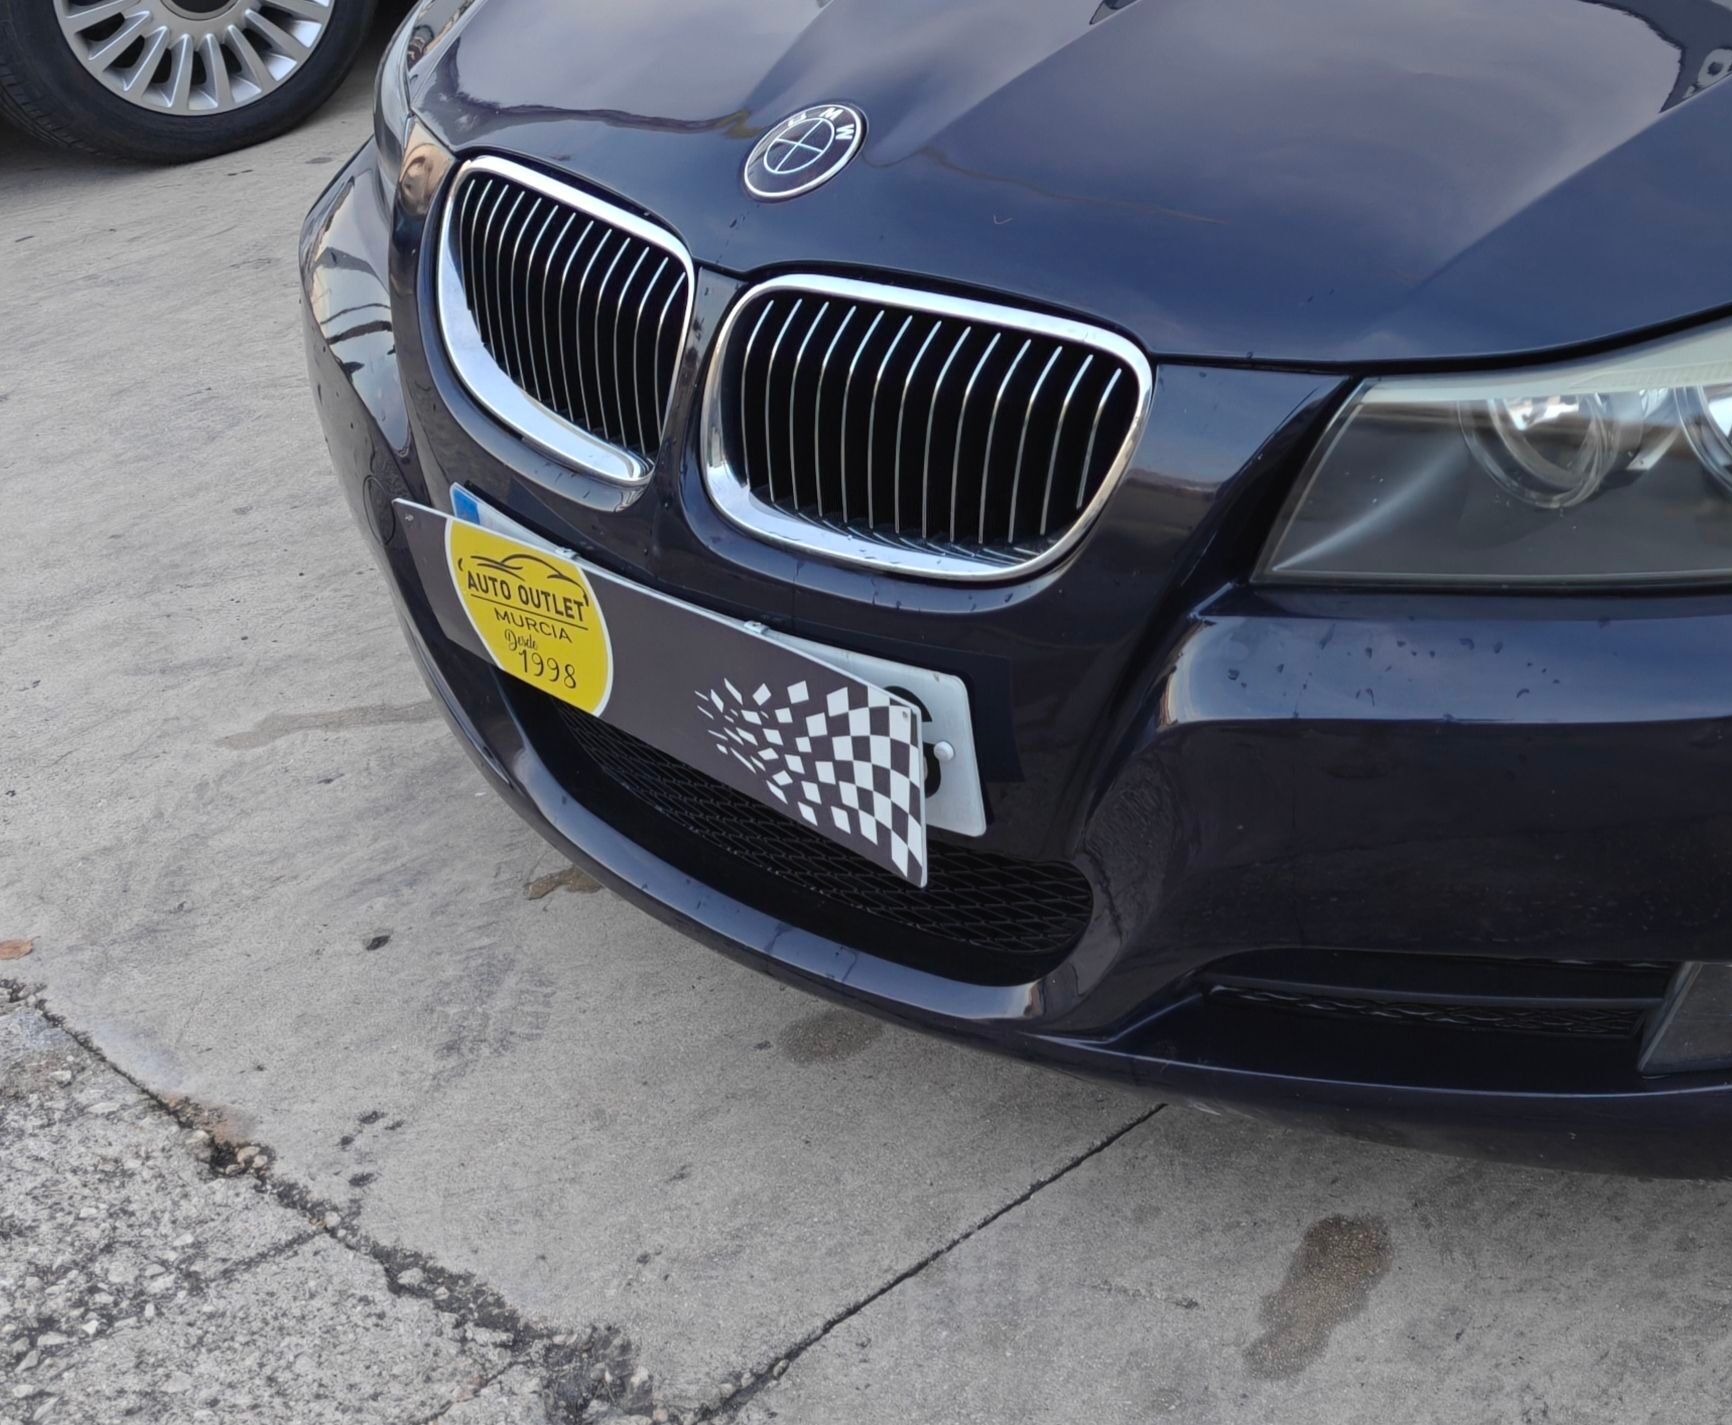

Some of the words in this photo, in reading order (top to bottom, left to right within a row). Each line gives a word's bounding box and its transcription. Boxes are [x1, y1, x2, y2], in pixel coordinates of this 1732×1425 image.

[467, 570, 512, 601] AUTO
[517, 584, 585, 623] OUTLET
[494, 607, 573, 644] MURCIA
[504, 628, 538, 652] Desde
[518, 648, 578, 690] 1998
